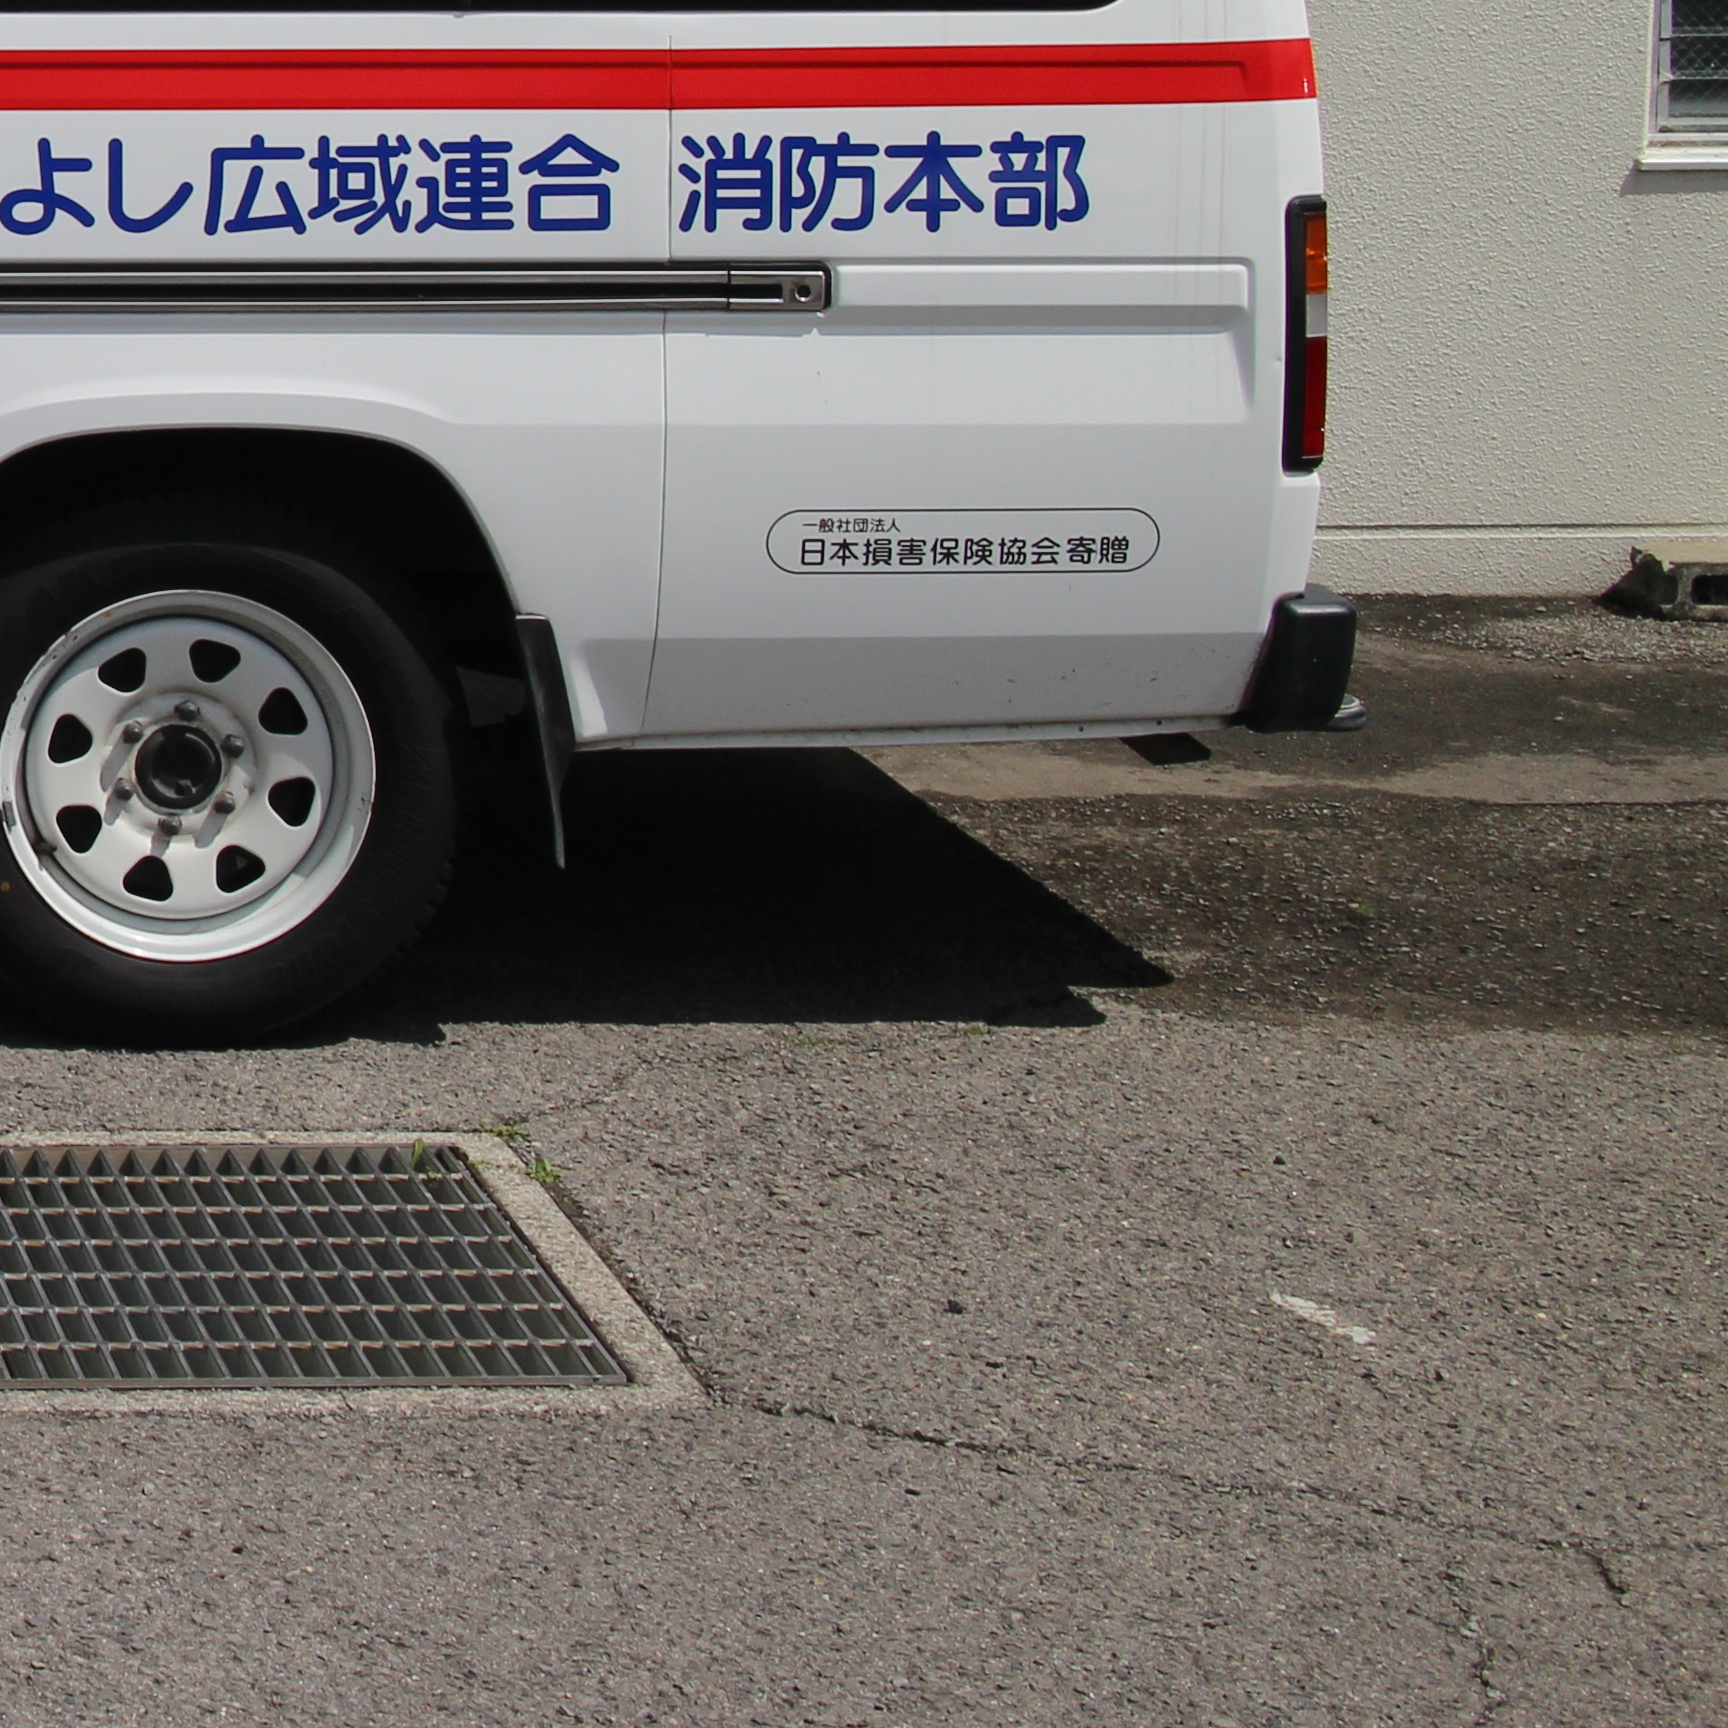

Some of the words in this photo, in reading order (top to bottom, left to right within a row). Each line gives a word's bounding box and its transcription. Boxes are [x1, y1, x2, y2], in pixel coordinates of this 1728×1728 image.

[678, 130, 1090, 233] 消防本部
[801, 517, 901, 533] 一般社団法人
